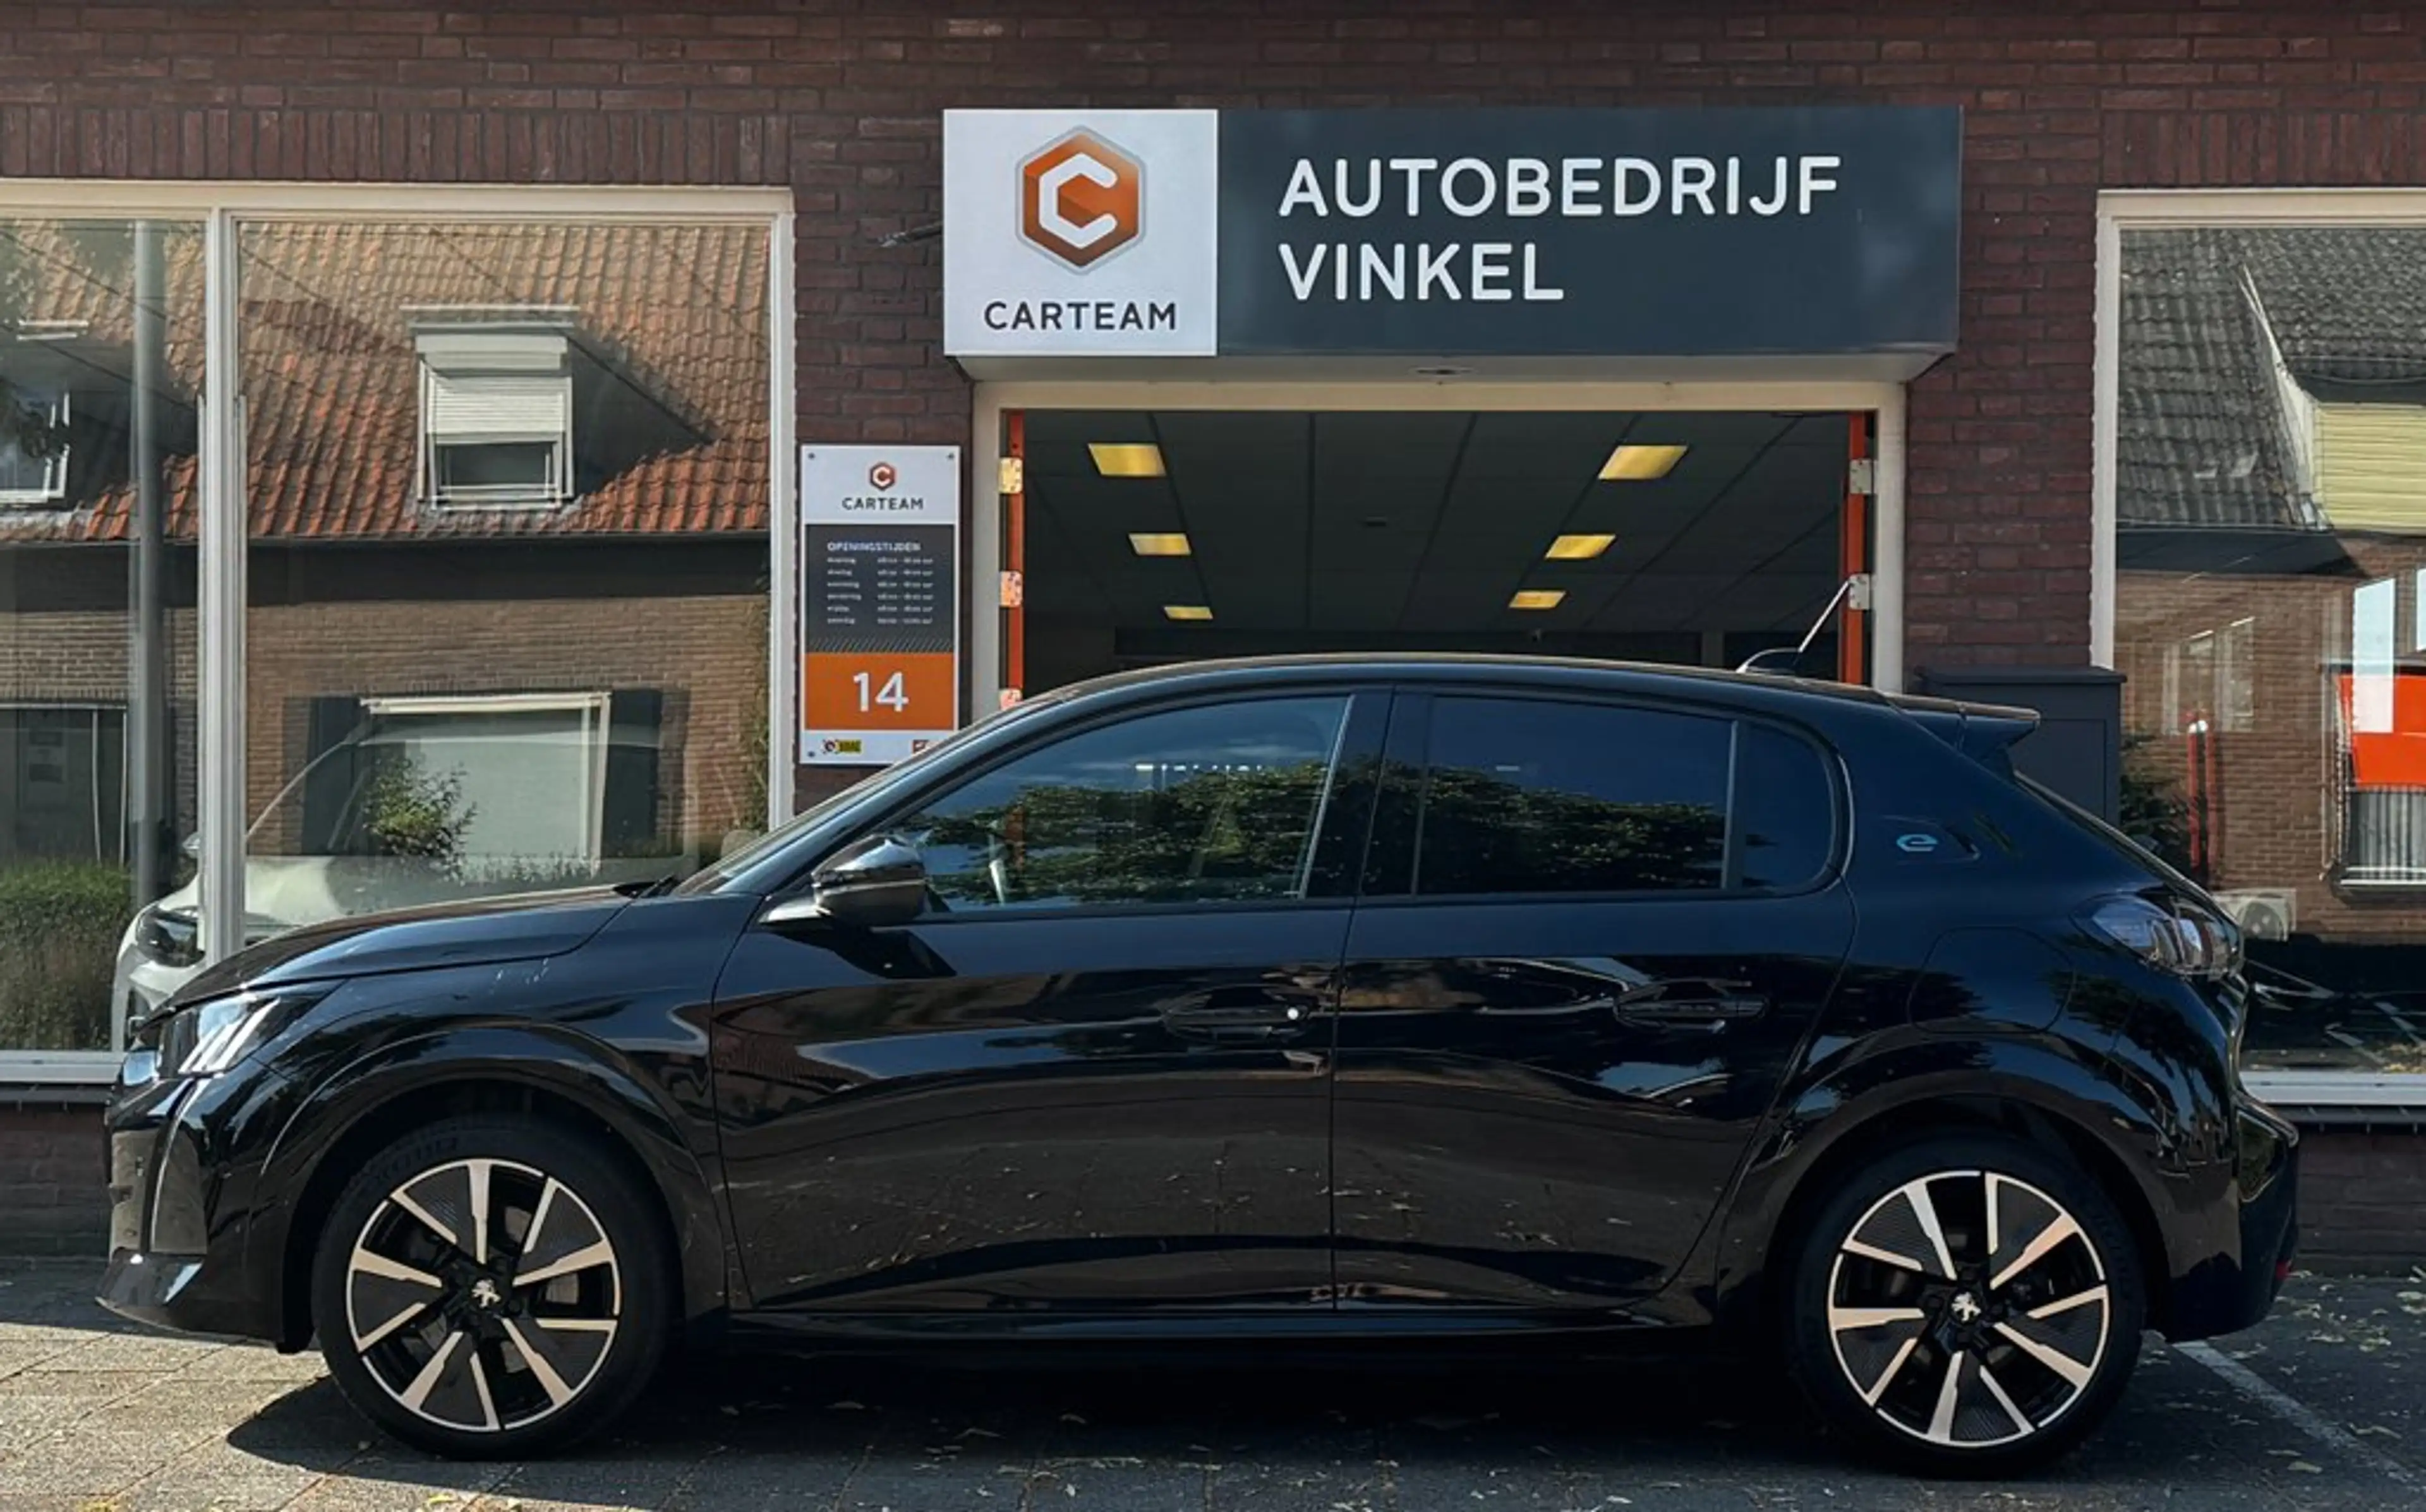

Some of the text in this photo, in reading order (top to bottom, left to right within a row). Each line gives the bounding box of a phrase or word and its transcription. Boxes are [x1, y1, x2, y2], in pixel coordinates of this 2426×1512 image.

[1279, 155, 1841, 217] AUTOBEDRIJF
[1279, 243, 1564, 301] VINKEL
[984, 301, 1176, 331] CARTEAM
[842, 496, 924, 510] CARTEAM
[853, 671, 909, 712] 14
